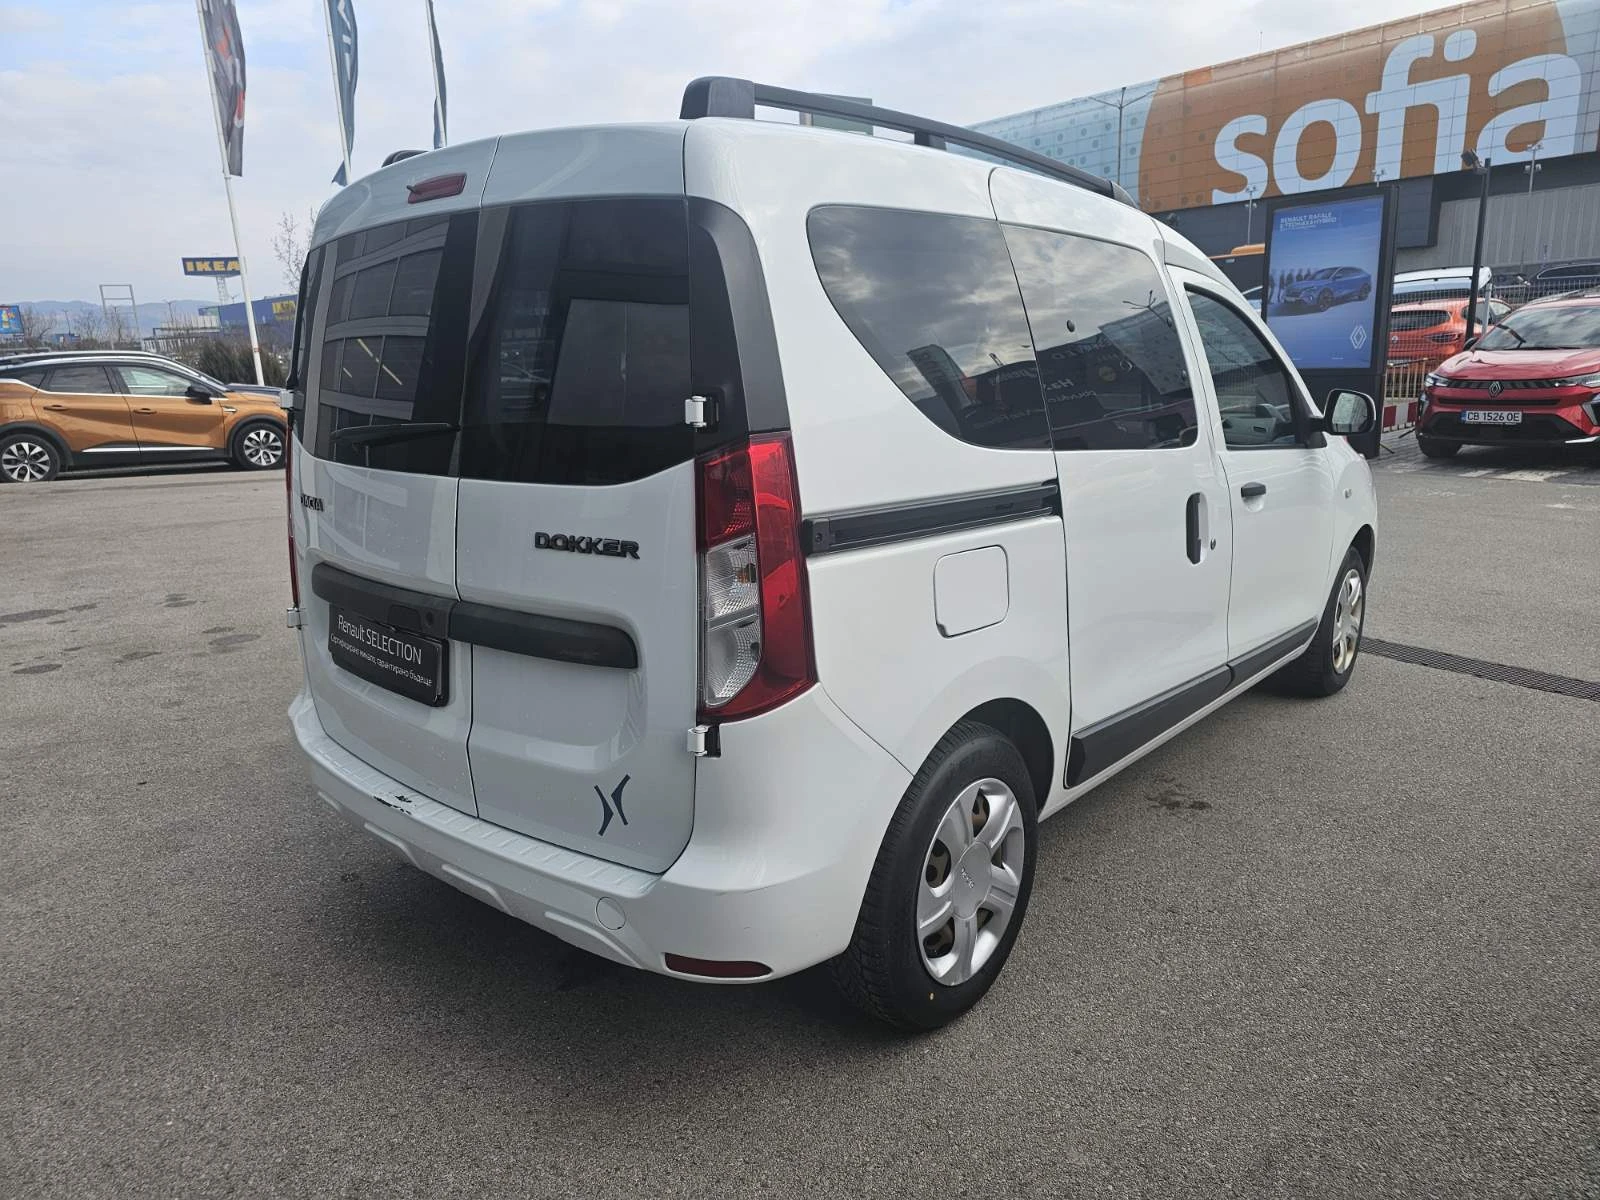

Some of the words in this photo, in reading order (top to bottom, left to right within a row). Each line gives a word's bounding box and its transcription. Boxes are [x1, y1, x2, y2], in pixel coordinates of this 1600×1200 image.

[1213, 29, 1581, 205] sofia
[185, 261, 240, 272] IKEA
[1483, 412, 1505, 421] 1526
[534, 531, 640, 560] DOKKER
[338, 614, 365, 642] Renault
[366, 628, 422, 665] SELECTION
